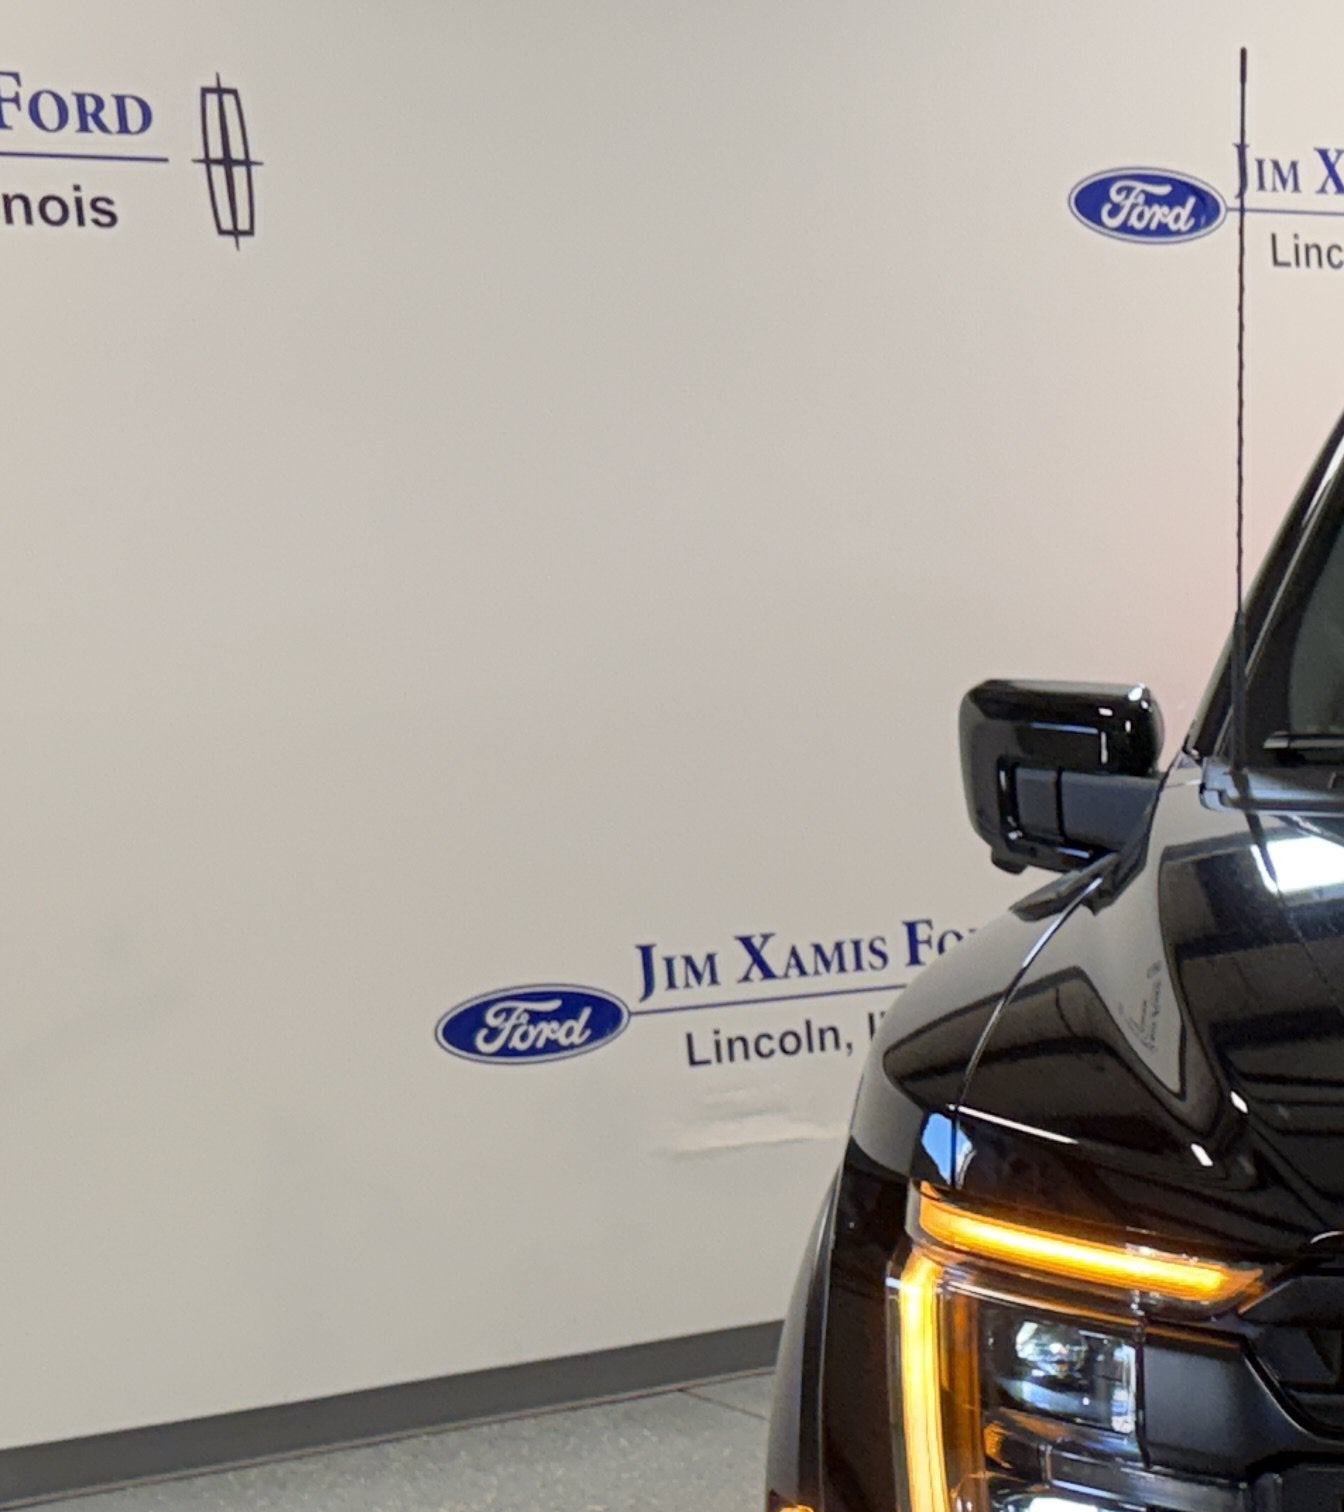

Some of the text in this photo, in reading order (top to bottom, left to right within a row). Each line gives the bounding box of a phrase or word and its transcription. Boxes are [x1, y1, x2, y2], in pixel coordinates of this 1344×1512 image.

[1100, 180, 1197, 233] Ford
[636, 943, 720, 1003] JIM
[735, 933, 889, 984] XAMIS
[476, 999, 592, 1055] Ford
[686, 1020, 854, 1067] Lincoln,
